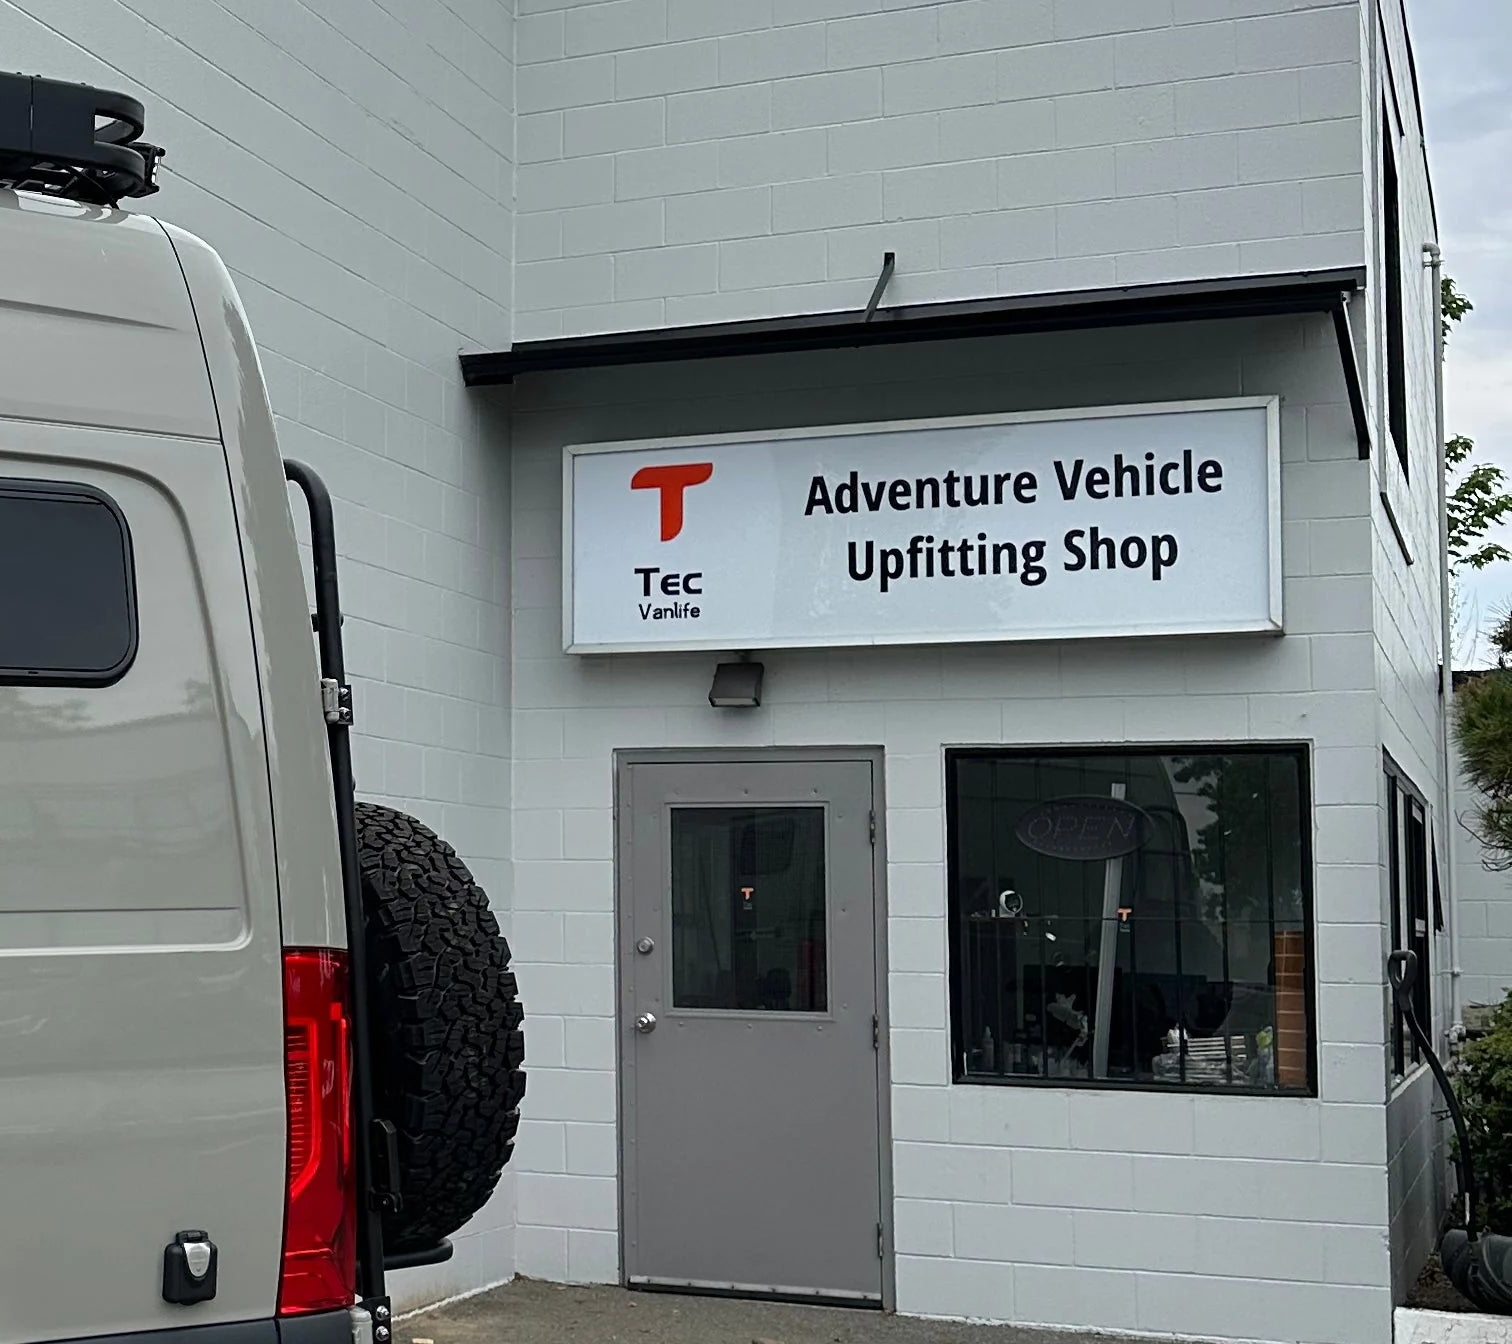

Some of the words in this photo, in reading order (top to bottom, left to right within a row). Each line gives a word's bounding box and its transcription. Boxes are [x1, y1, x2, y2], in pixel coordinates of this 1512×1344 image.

[804, 471, 1038, 516] Adventure
[1053, 449, 1223, 501] Vehicle
[847, 532, 1048, 593] Upfitting
[1063, 526, 1178, 581] Shop
[638, 602, 701, 621] Vanlife
[1027, 815, 1137, 840] OPEN
